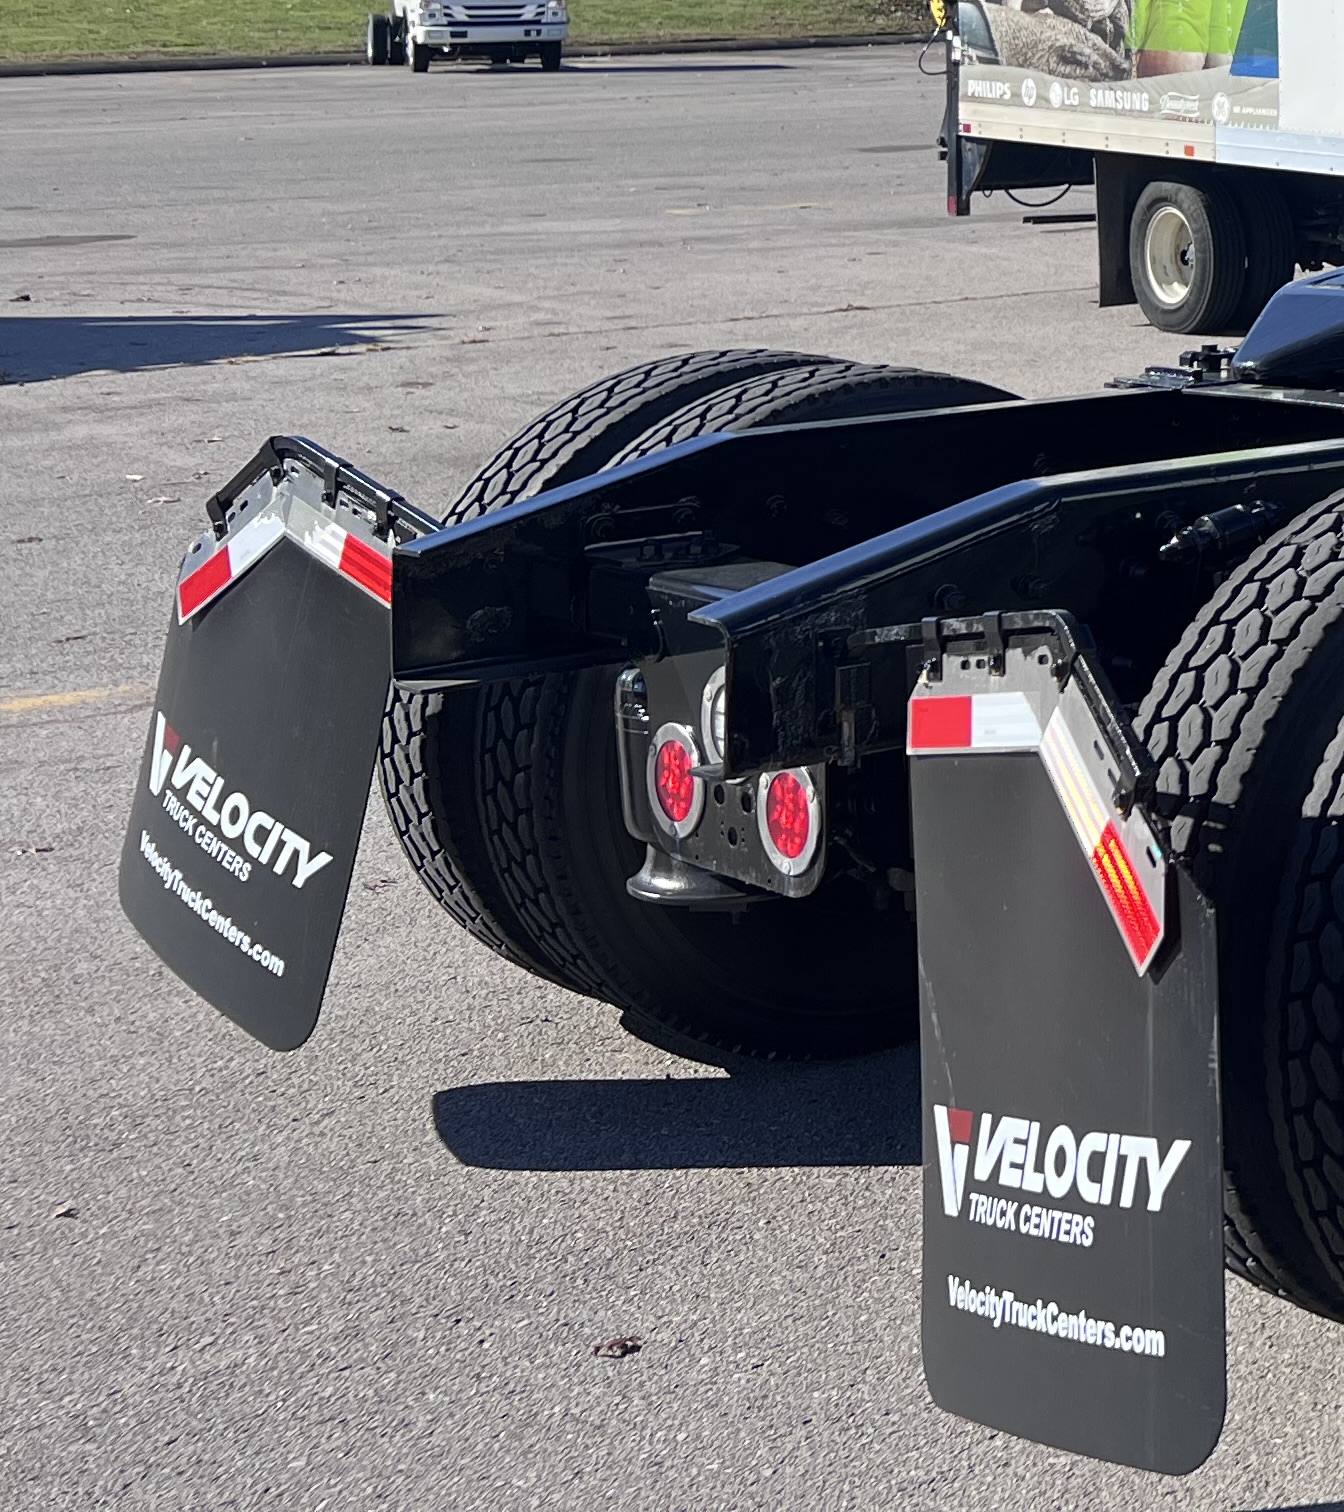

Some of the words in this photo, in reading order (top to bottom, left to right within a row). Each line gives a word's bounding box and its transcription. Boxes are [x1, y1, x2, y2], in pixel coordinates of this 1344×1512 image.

[967, 79, 1011, 100] PHILIPS
[1063, 87, 1079, 106] LG
[1089, 88, 1149, 111] SAMSUNG
[162, 789, 198, 837] TRUCK
[194, 824, 252, 883] CENTERS
[171, 744, 334, 889] VELOCITY
[139, 829, 286, 978] VelocityTruckCenters.com
[973, 1112, 1192, 1212] VELOCITY
[968, 1192, 1018, 1232] TRUCK
[1019, 1202, 1095, 1248] CENTERS
[947, 1274, 1166, 1358] VelocityTruckCenters.com
